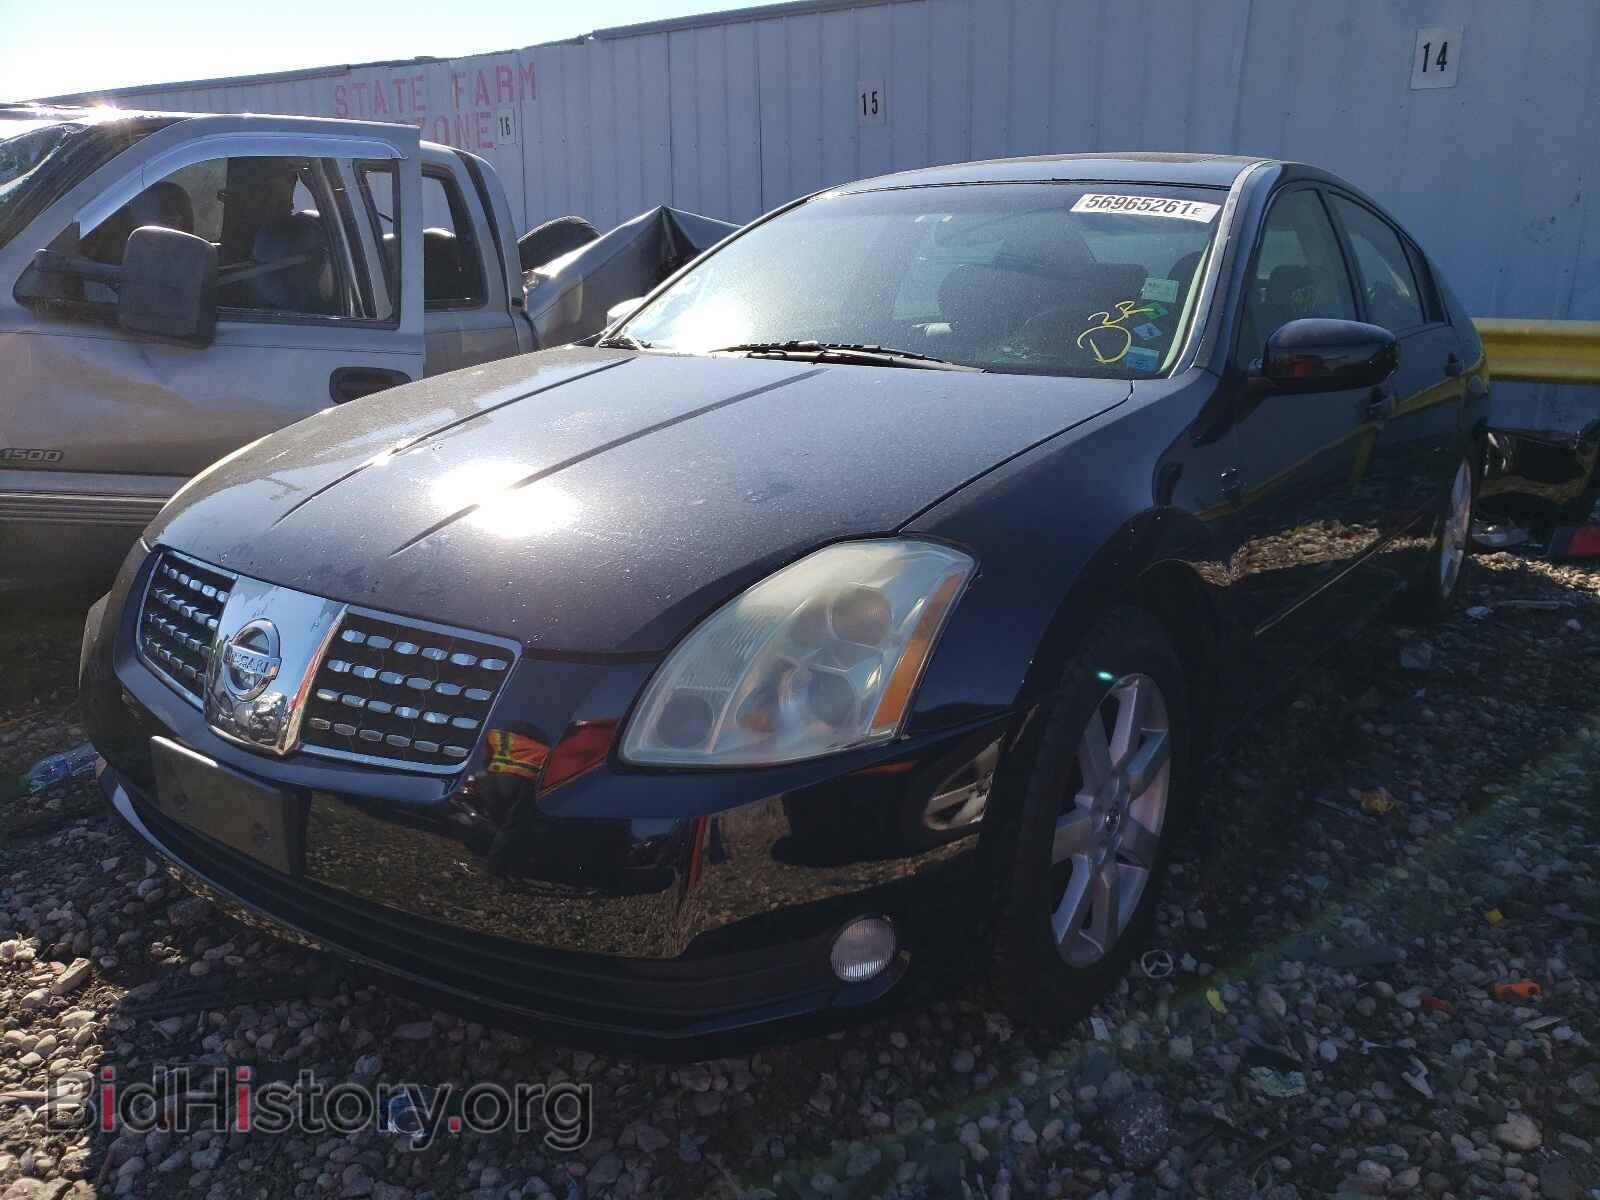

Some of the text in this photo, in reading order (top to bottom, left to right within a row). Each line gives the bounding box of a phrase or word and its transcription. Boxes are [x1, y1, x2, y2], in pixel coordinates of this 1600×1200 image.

[1422, 41, 1448, 73] 14
[333, 62, 537, 119] STATE FARM
[861, 90, 878, 116] 15
[498, 116, 511, 137] 16
[3, 448, 63, 462] 1500
